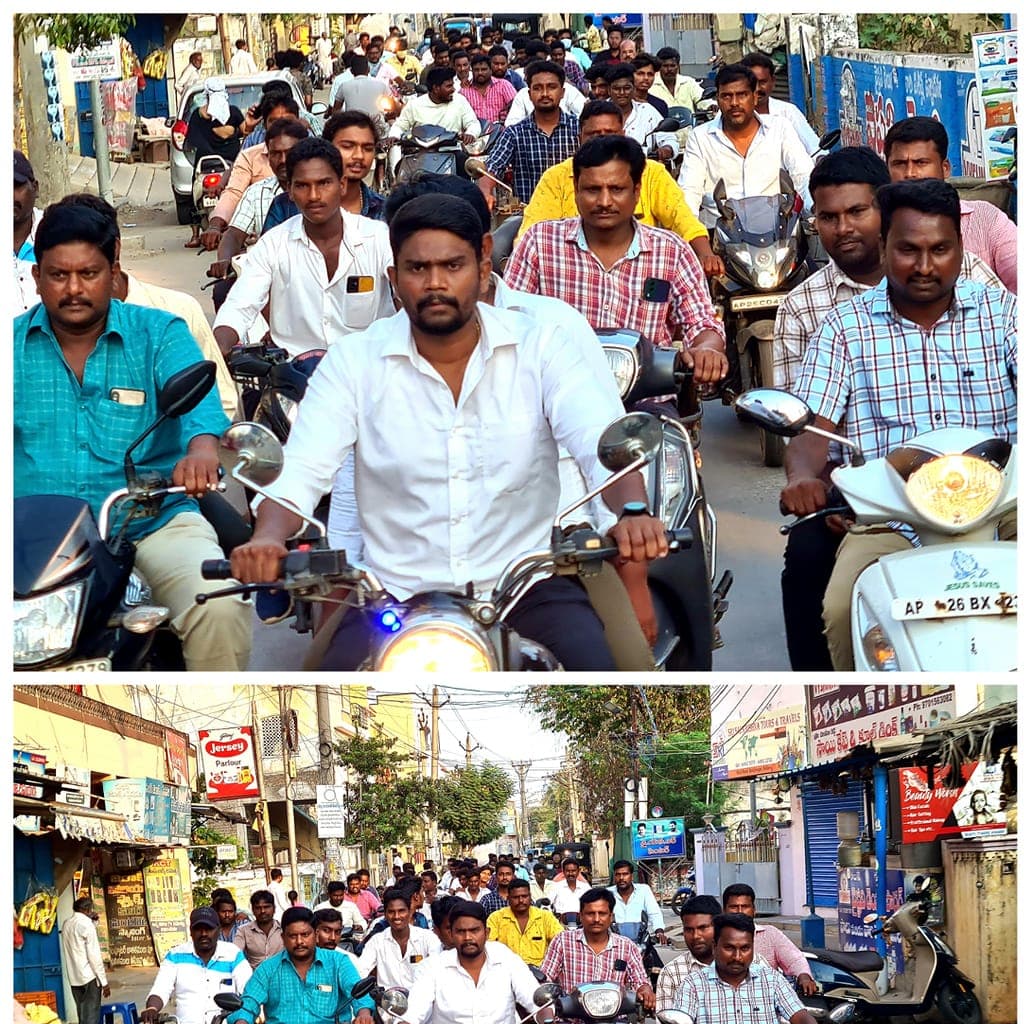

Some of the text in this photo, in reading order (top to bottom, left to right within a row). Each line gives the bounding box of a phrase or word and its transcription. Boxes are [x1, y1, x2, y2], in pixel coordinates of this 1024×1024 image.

[905, 594, 1018, 616] AP 26 BX 2
[209, 742, 244, 754] Jersey
